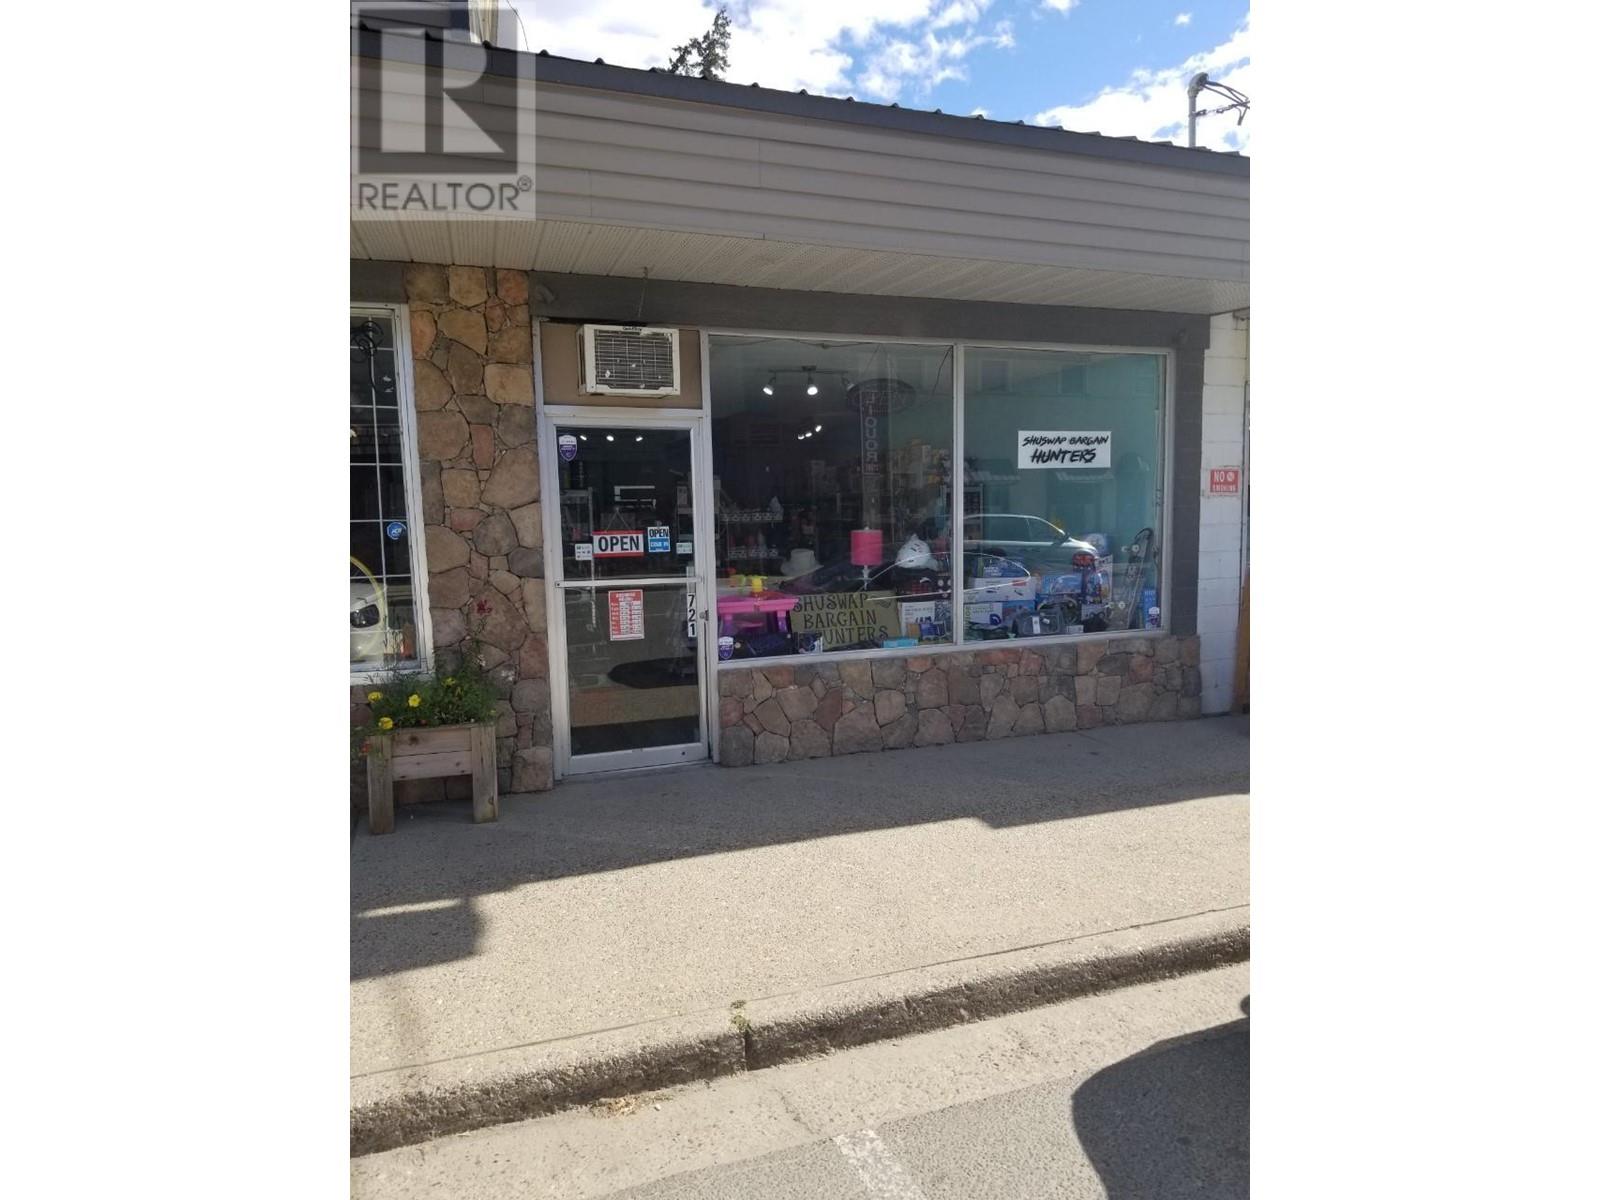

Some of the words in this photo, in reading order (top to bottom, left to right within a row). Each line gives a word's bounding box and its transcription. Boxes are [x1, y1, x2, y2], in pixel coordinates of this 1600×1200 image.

[1022, 435, 1067, 447] SHUSWAP
[1069, 435, 1109, 446] BARGAIN
[1031, 448, 1096, 464] HUNTERS
[1213, 471, 1225, 482] NO
[649, 528, 669, 538] OPEN
[599, 535, 640, 552] OPEN
[687, 594, 696, 636] 721
[803, 609, 877, 629] BARGAIN
[823, 625, 889, 645] UNTERS
